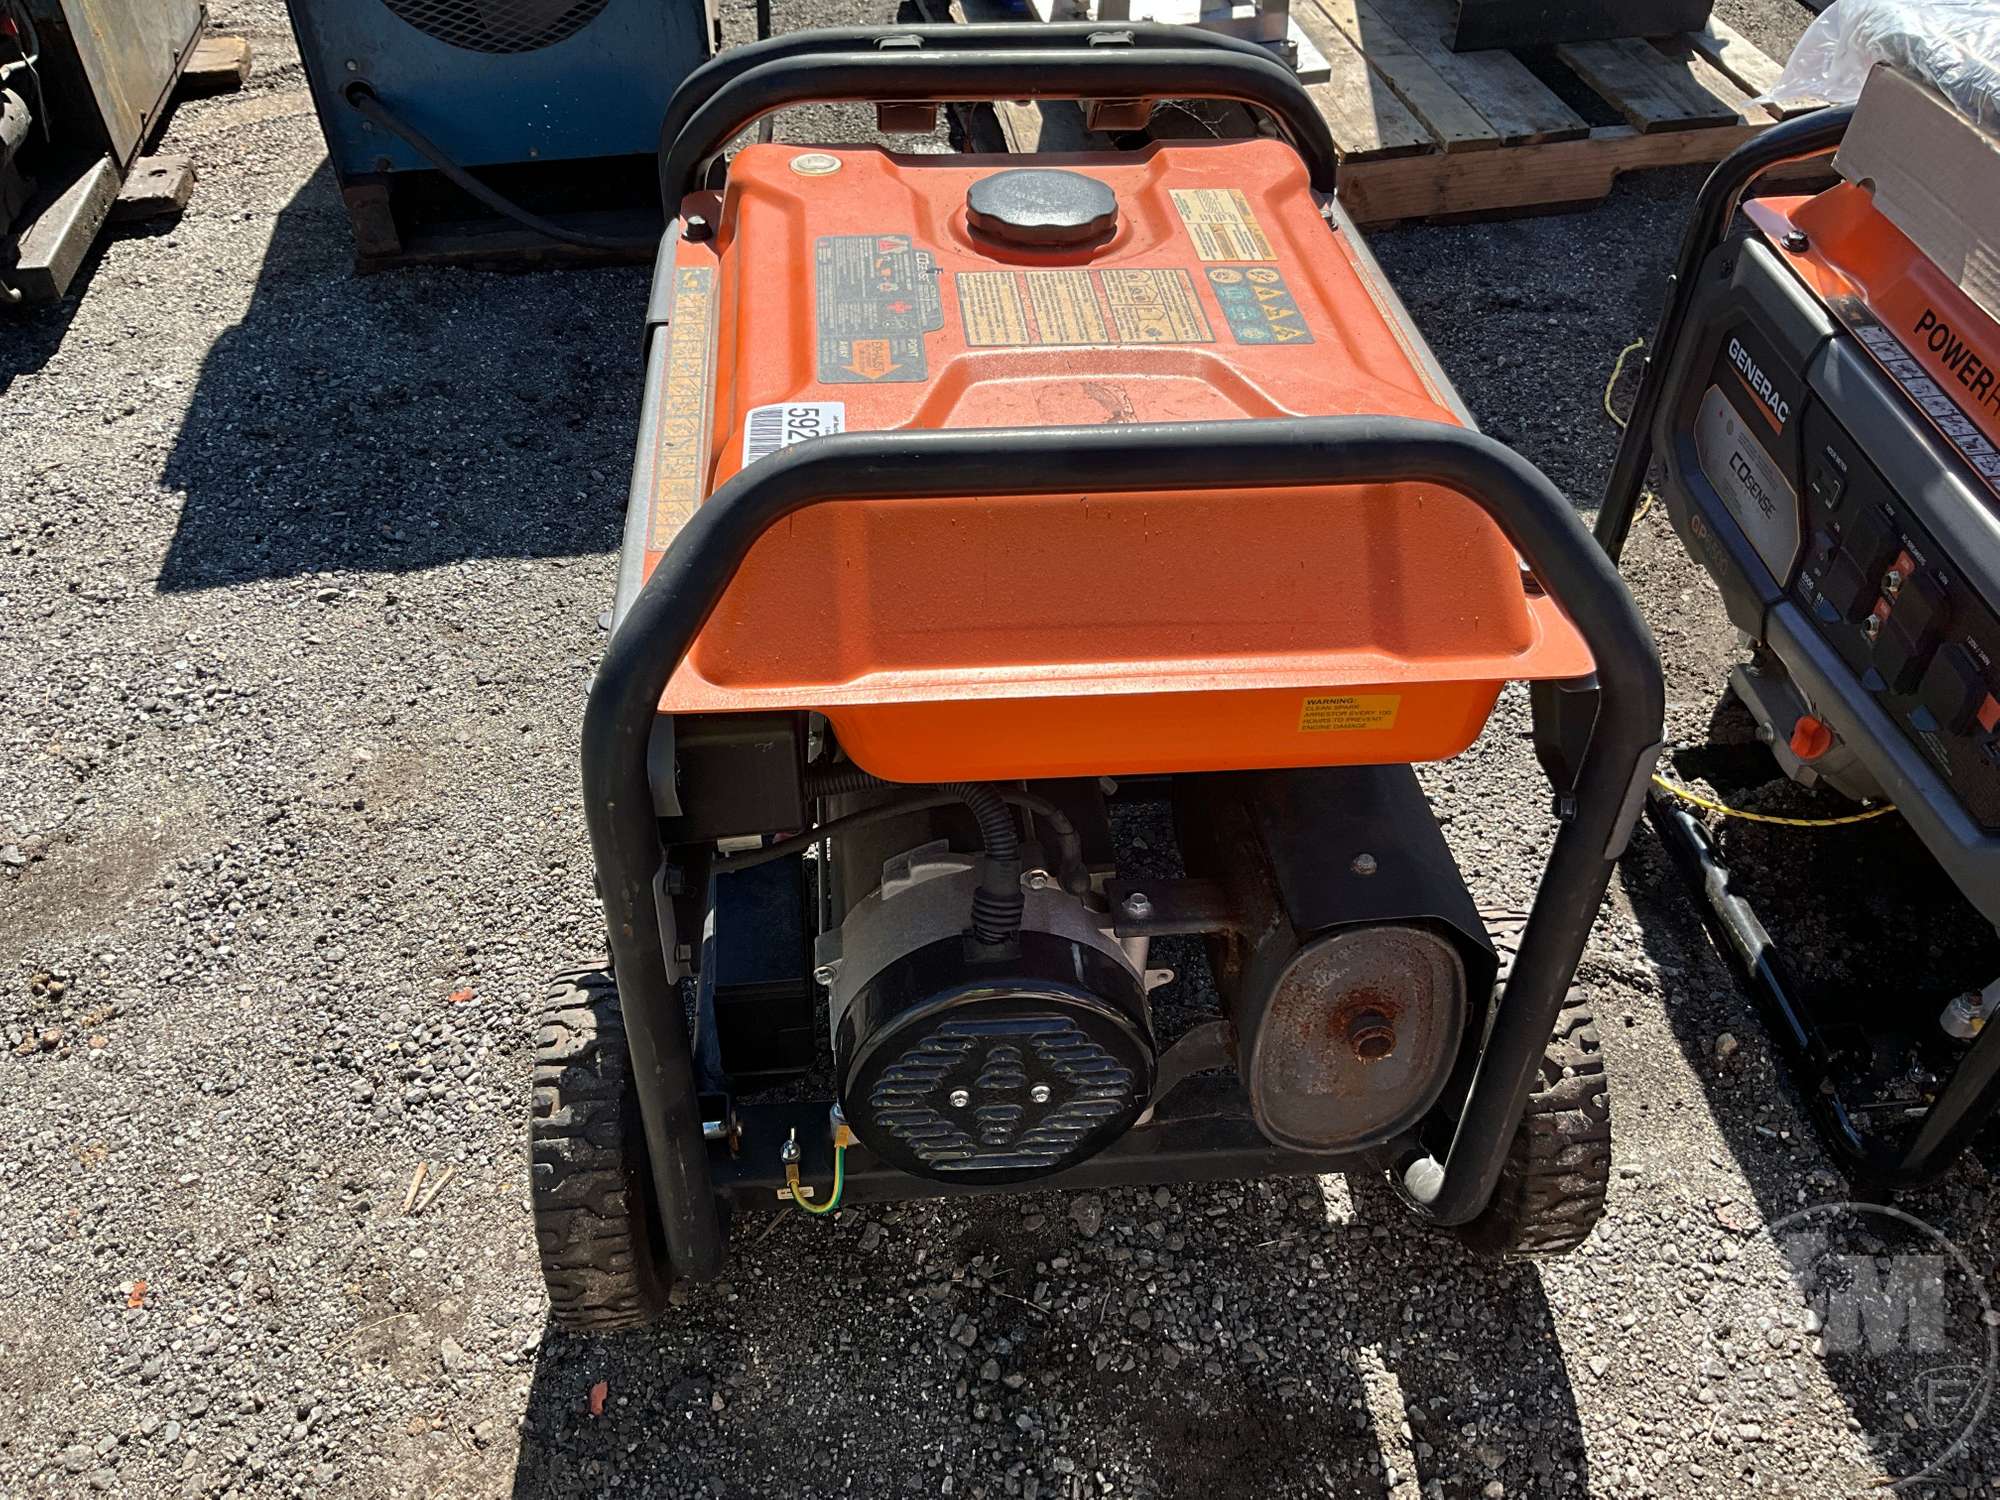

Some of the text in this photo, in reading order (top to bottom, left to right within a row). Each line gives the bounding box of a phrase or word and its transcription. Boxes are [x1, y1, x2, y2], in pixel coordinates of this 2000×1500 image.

[1728, 337, 1789, 423] GENERAC
[788, 408, 819, 446] 592
[1728, 451, 1777, 521] COSENSE
